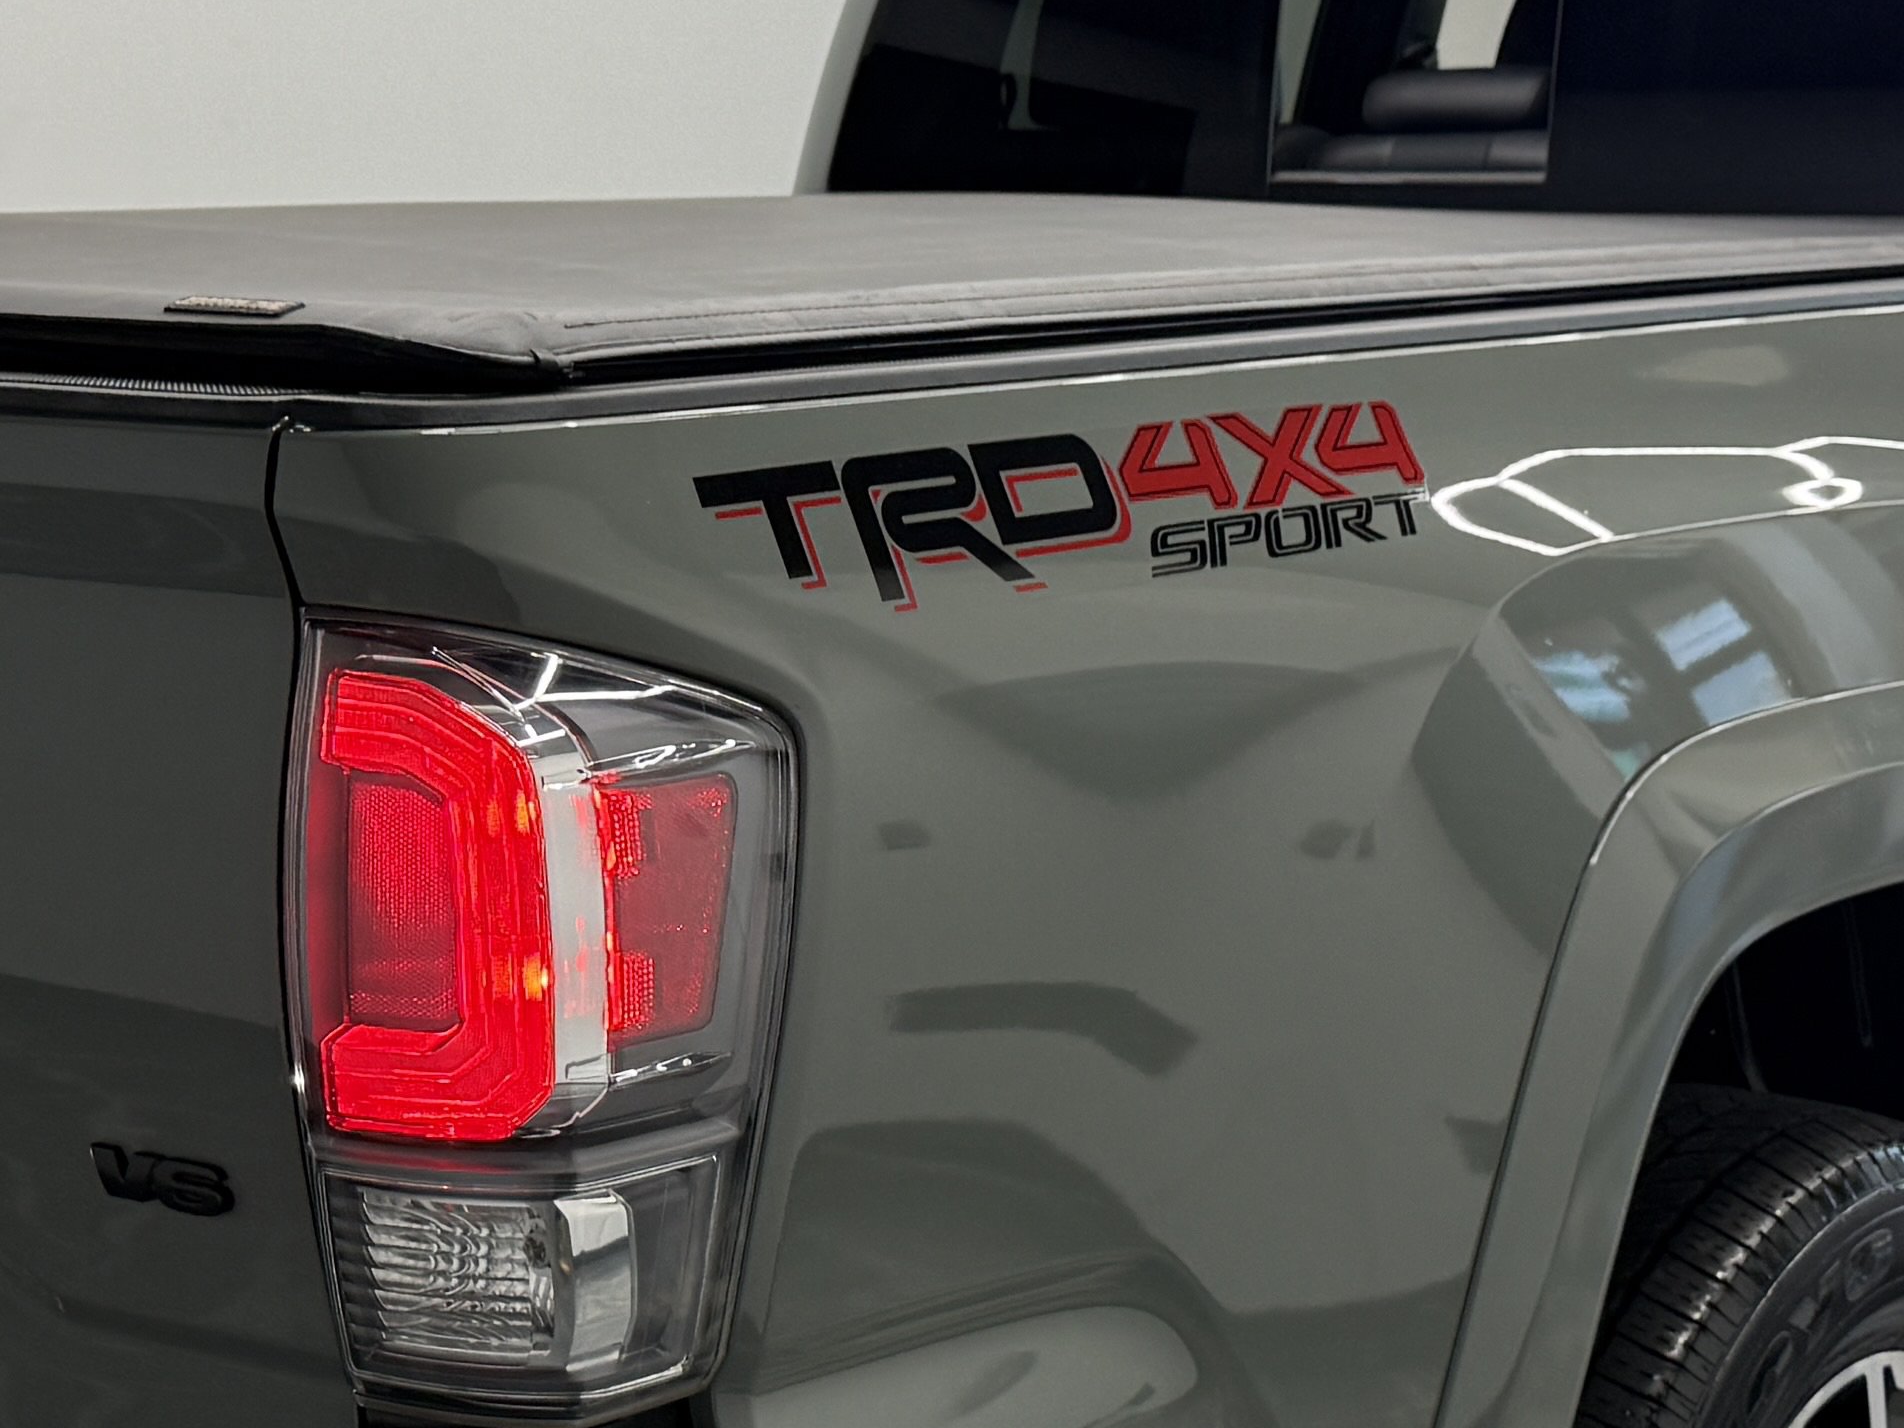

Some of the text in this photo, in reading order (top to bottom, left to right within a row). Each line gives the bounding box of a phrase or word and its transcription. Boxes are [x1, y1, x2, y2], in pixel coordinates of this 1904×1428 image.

[693, 433, 1133, 612] TRD
[1150, 493, 1428, 580] SPORT
[90, 1141, 235, 1217] V6
